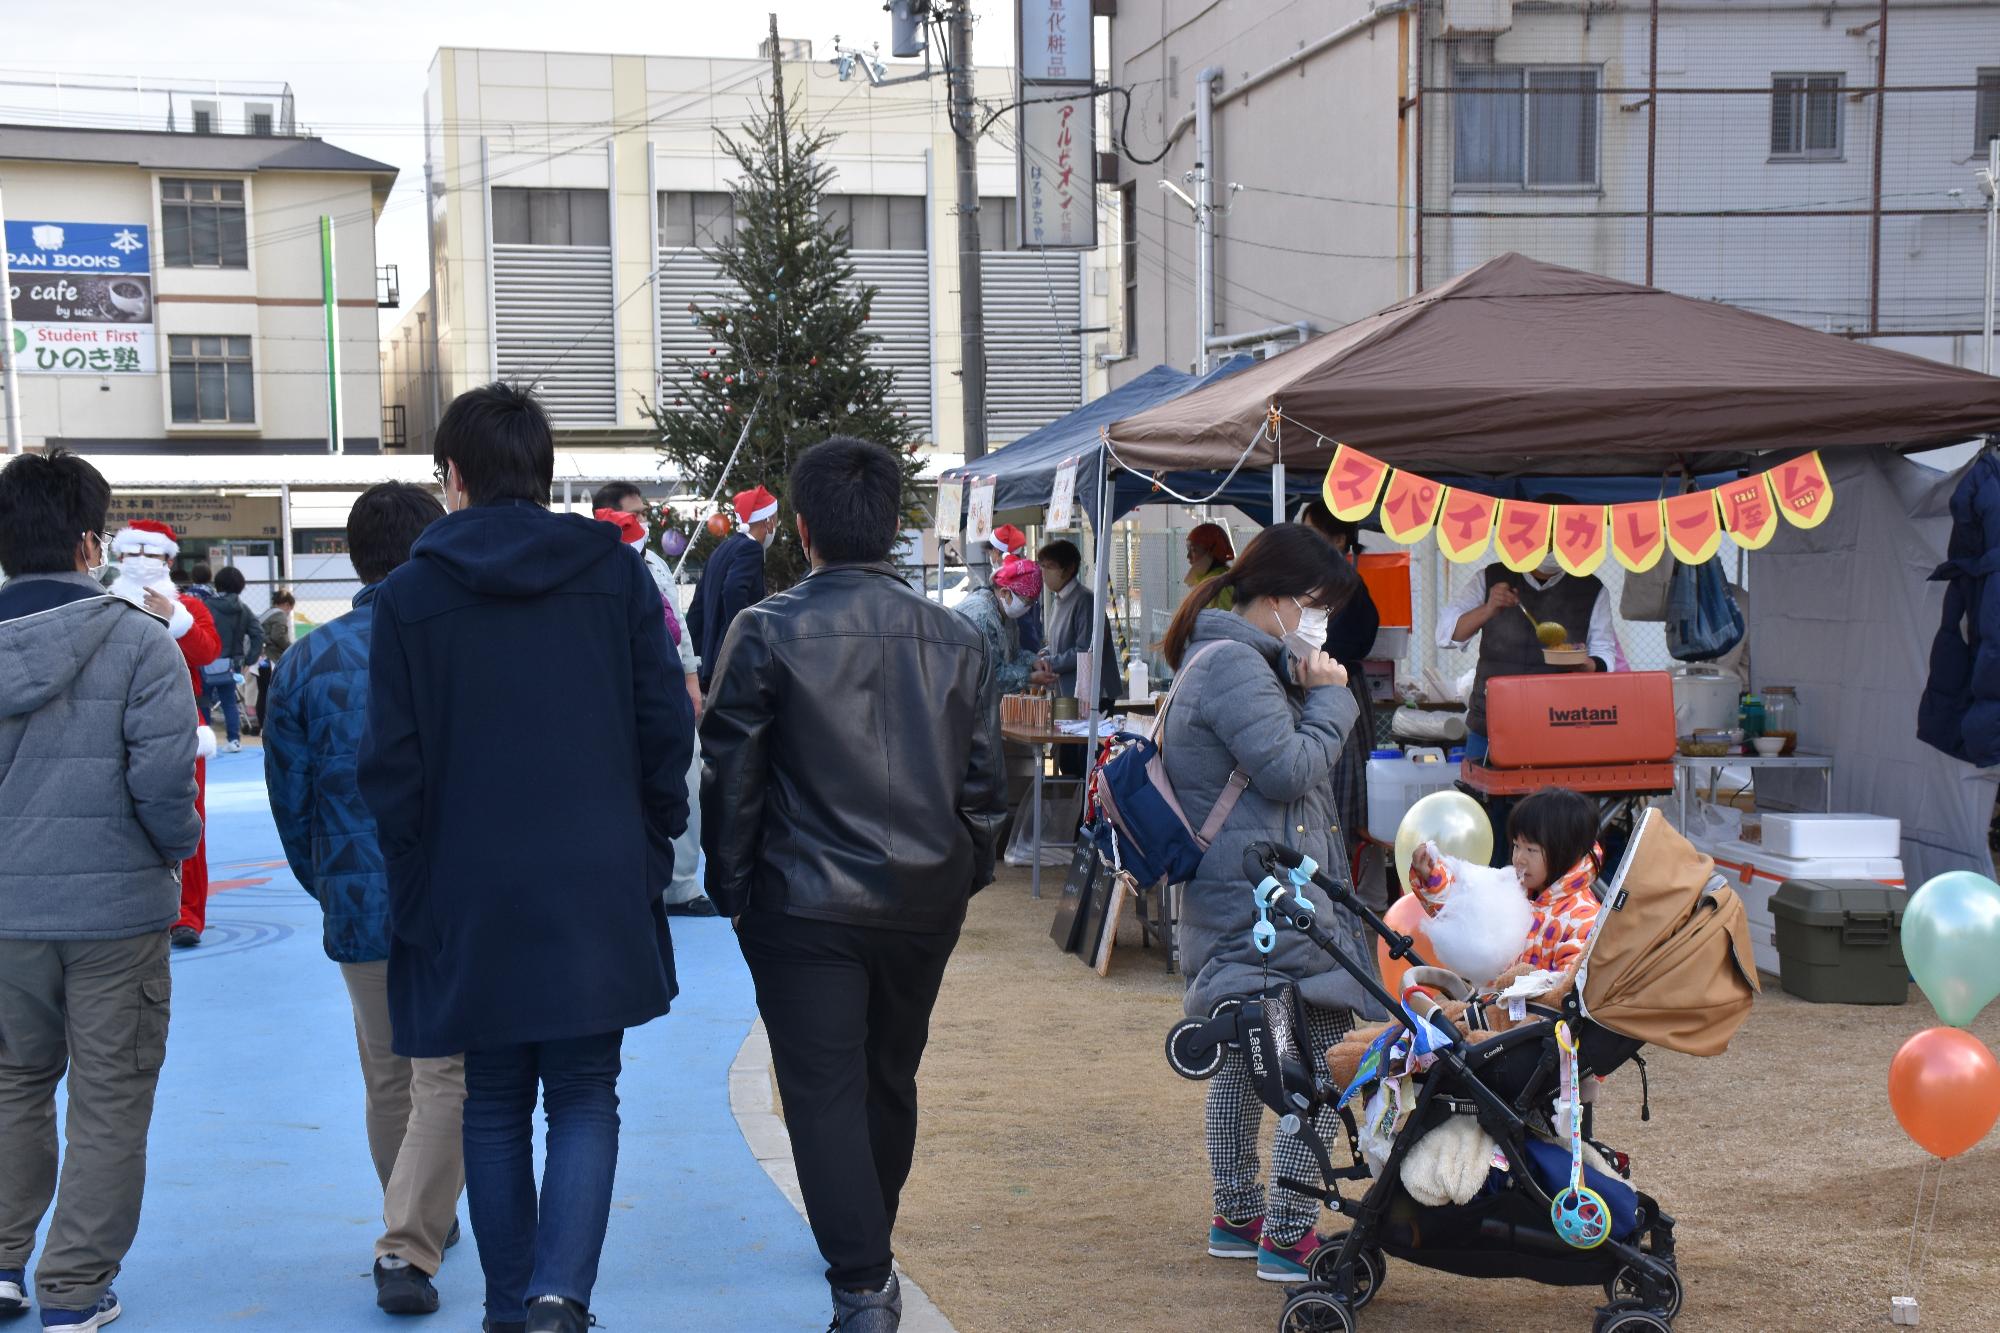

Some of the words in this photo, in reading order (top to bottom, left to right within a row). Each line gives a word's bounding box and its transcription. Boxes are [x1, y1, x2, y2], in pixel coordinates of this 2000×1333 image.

[110, 228, 144, 255] 本
[53, 253, 121, 269] BOOKS
[30, 279, 79, 302] cafe
[56, 304, 71, 320] by
[74, 307, 94, 317] ucc
[38, 328, 98, 342] Student
[106, 329, 139, 343] First
[35, 346, 141, 372] ひのき塾
[1549, 705, 1618, 722] Iwatani
[1248, 1027, 1268, 1076] Lascal
[1483, 1044, 1505, 1059] Combi
